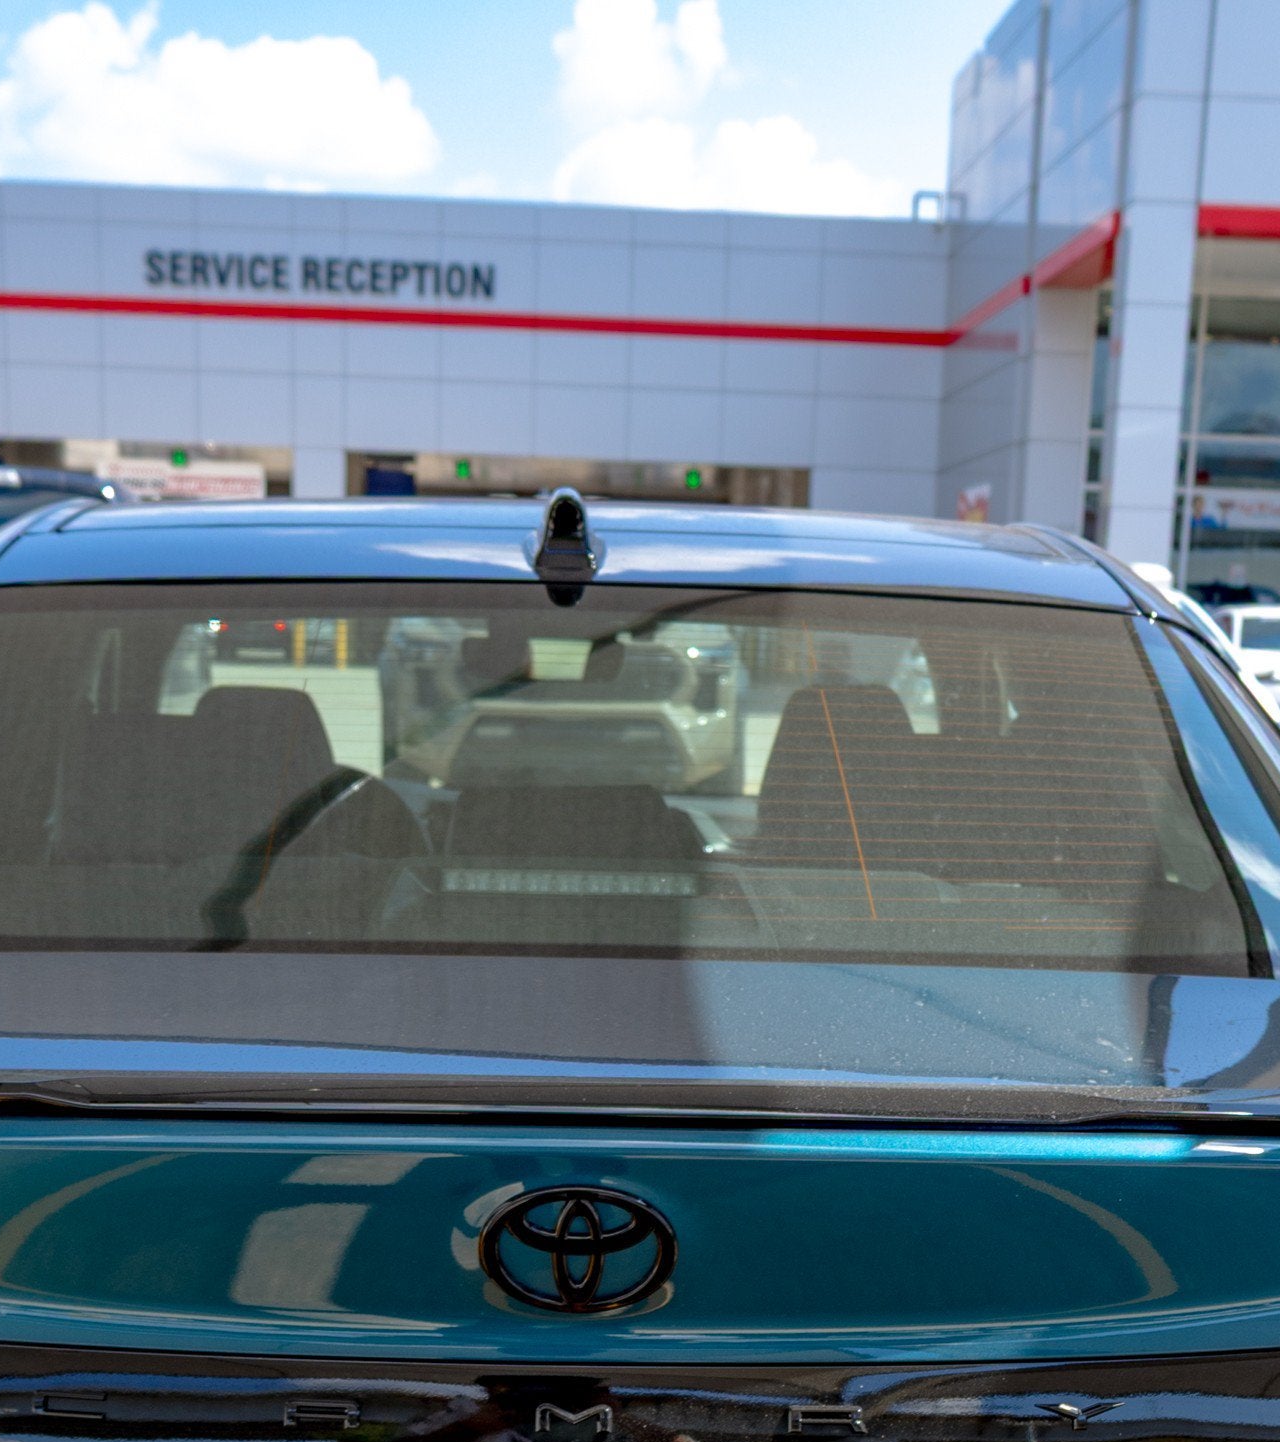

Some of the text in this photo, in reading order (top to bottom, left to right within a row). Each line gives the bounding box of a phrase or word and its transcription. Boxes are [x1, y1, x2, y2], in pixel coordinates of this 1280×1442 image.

[144, 249, 496, 298] SERVICE RECEPTION
[33, 1391, 1125, 1433] CAMRY
